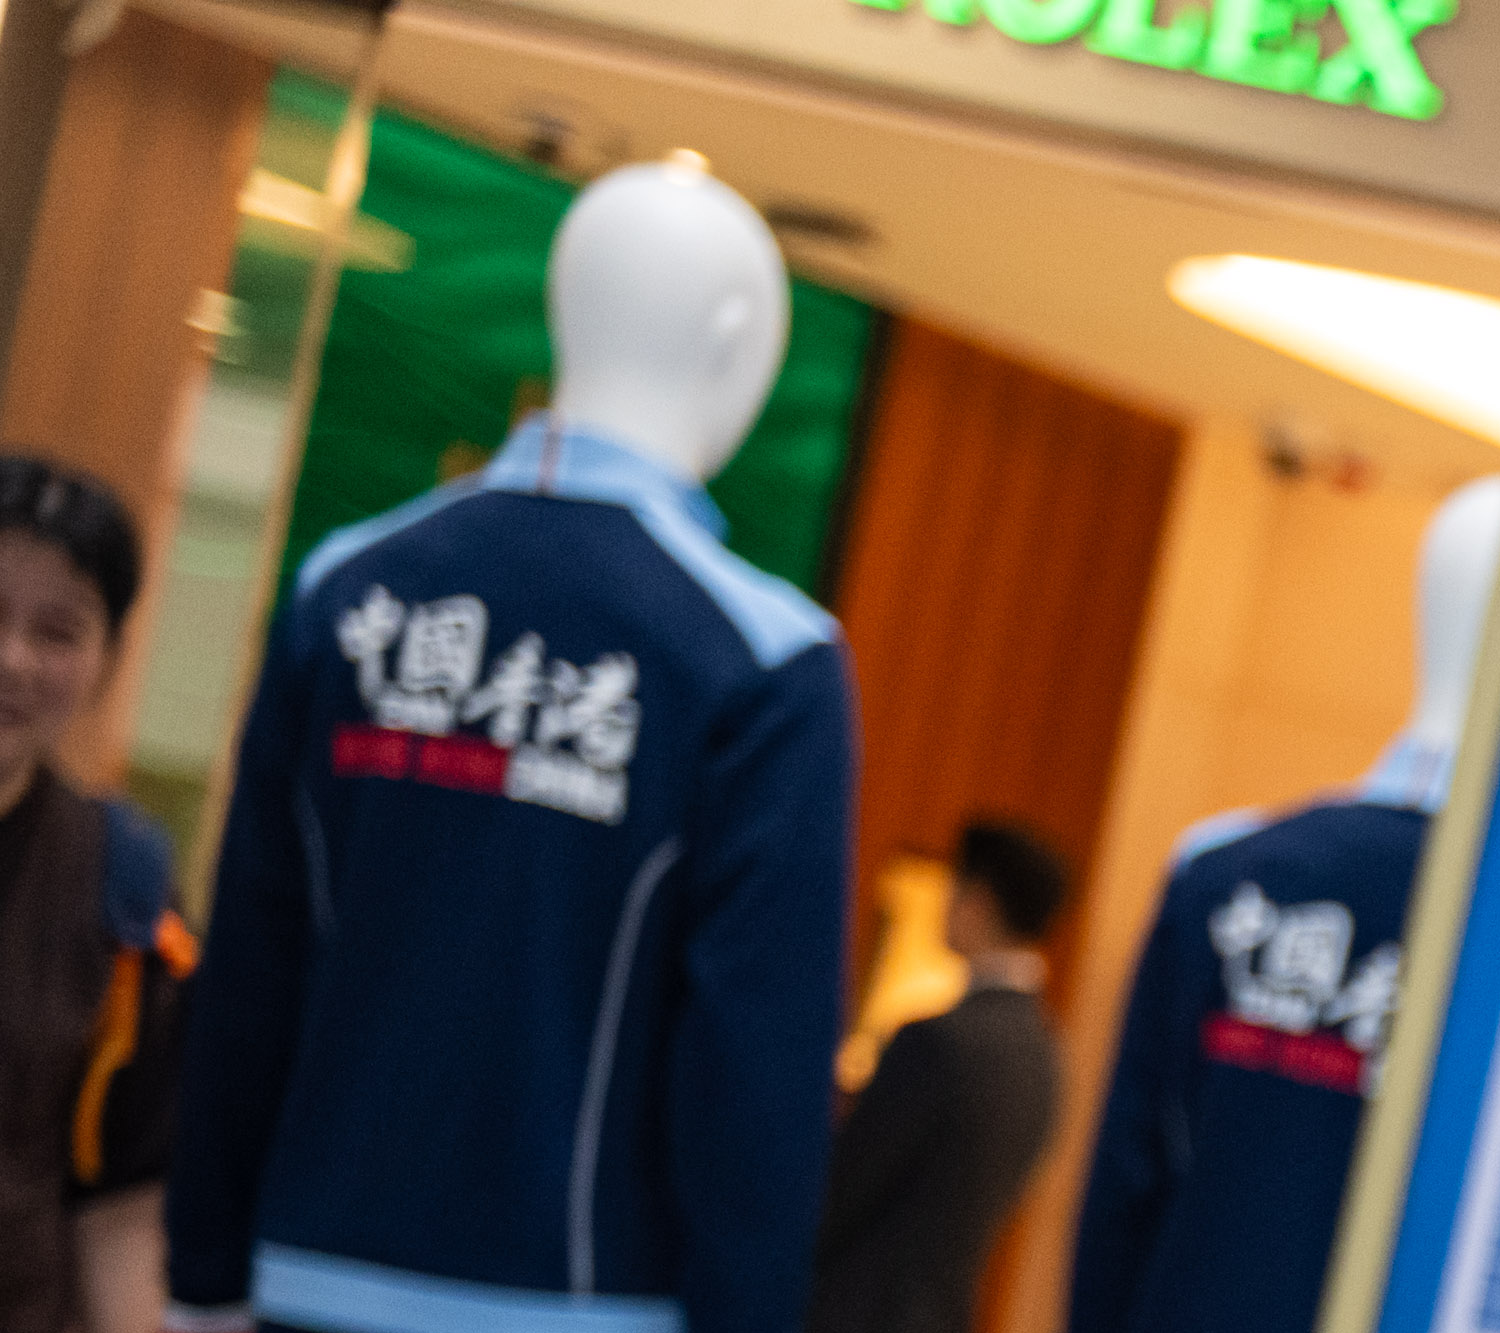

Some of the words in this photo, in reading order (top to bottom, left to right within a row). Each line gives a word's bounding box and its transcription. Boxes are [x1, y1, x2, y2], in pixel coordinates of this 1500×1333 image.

[845, 0, 1458, 121] LEX
[1207, 880, 1402, 1052] 中國香
